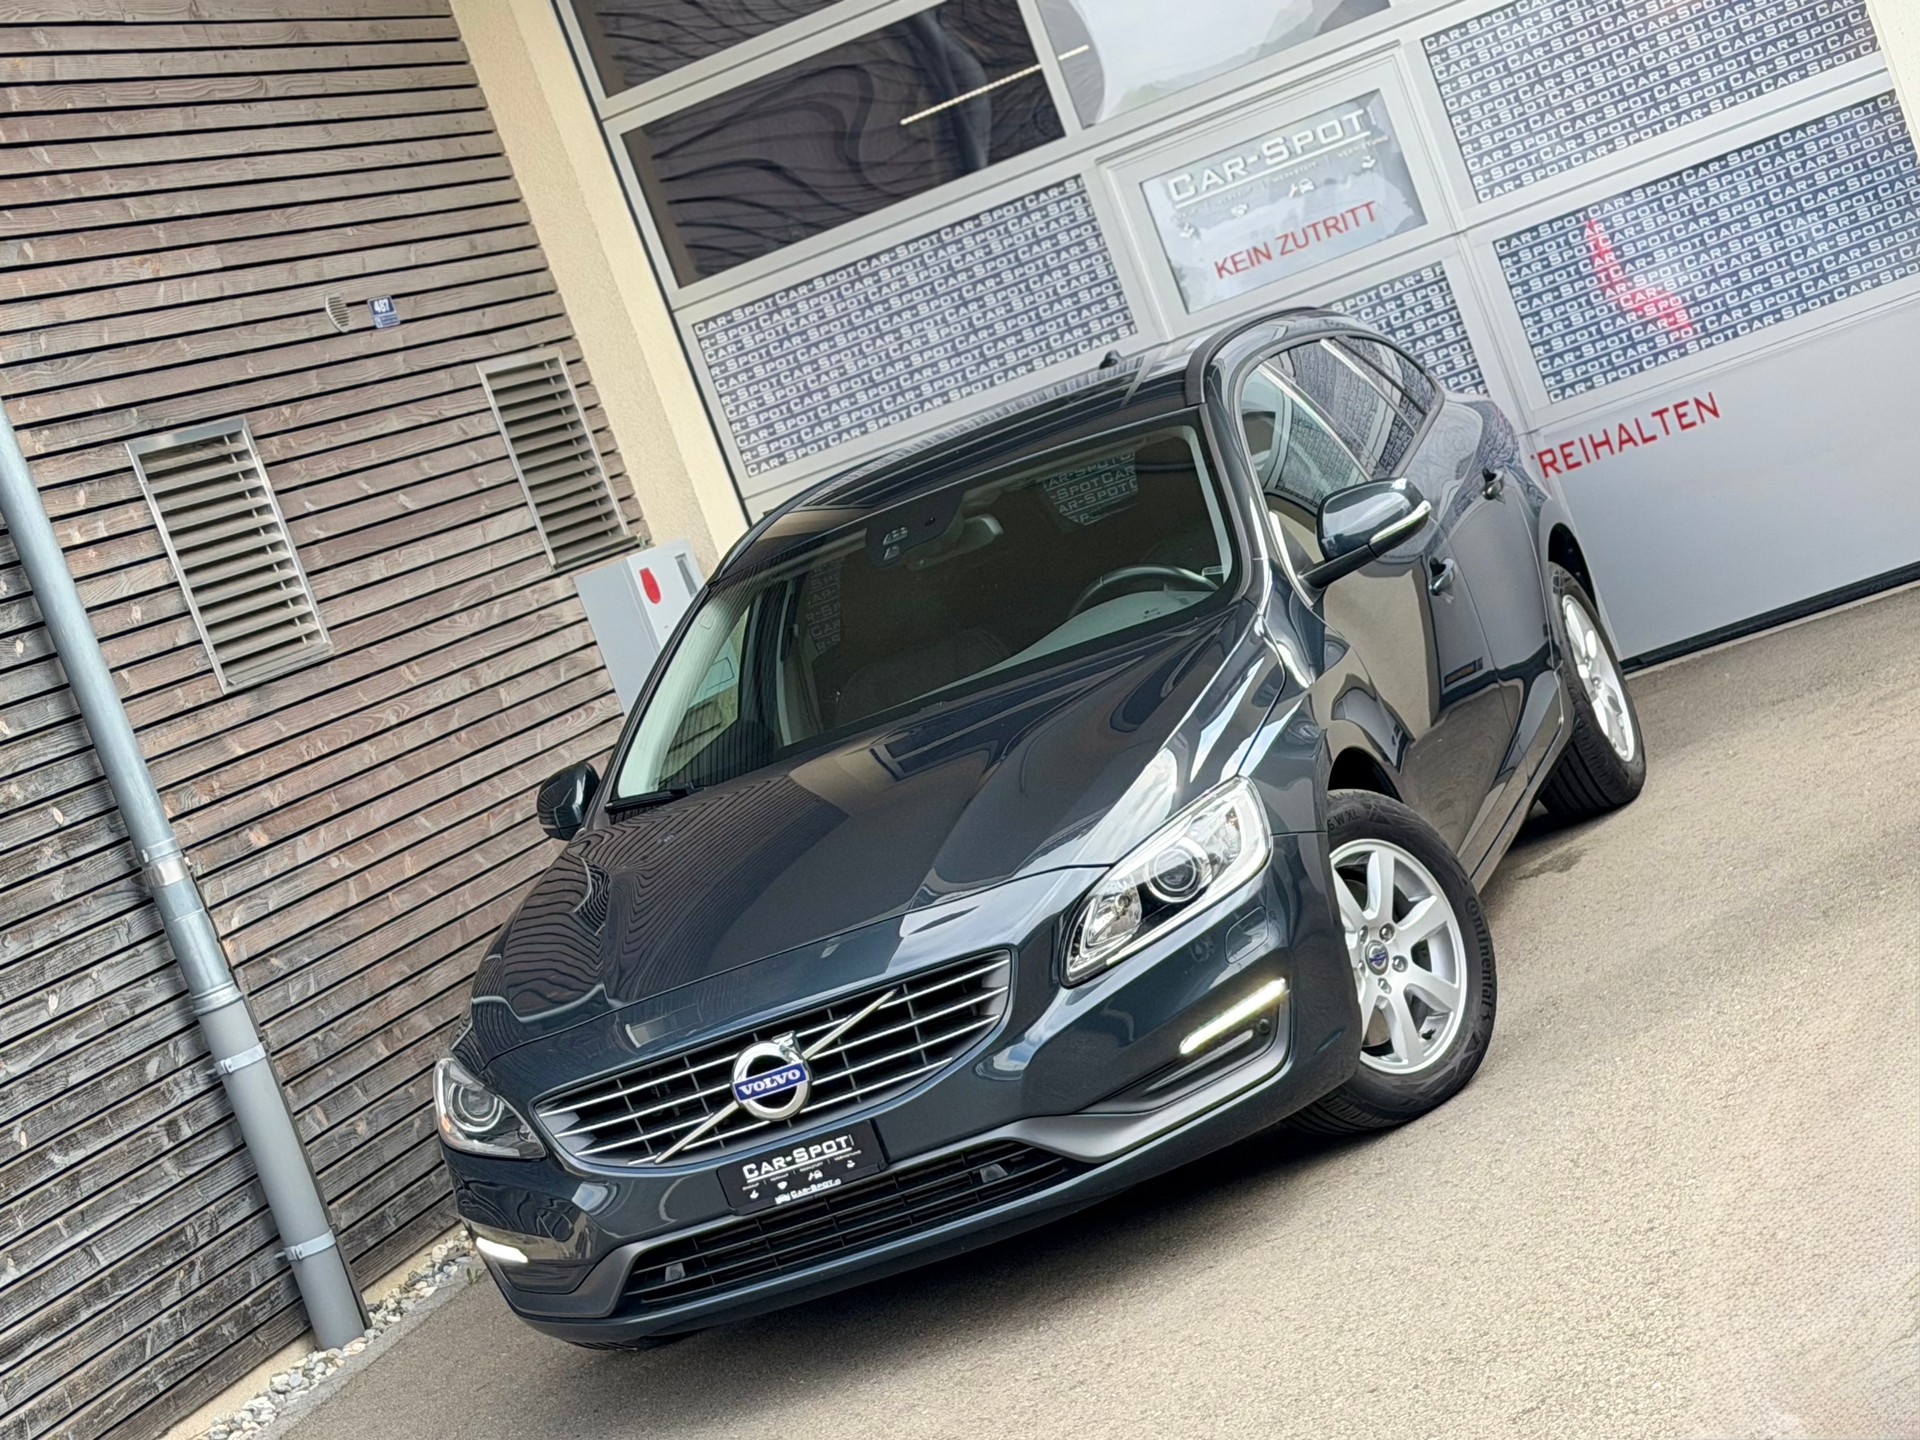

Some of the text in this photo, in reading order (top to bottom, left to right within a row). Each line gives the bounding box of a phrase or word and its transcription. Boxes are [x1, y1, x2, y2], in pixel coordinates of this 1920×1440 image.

[1423, 6, 1513, 50] CAR-SPOT
[1433, 0, 1617, 79] CAR-SPOT CAR-SPOT
[1444, 67, 1535, 111] CAR-SPOT
[1536, 30, 1628, 74] CAR-SPOT
[1454, 22, 1735, 140] CAR-SPOT CAR-SPOT CAR-SPOT
[1506, 24, 1598, 68] CAR-SPOT
[1517, 55, 1609, 99] CAR-SPOT
[1611, 18, 1704, 62] CAR-SPOT
[1527, 85, 1620, 129] CAR-SPOT
[1621, 48, 1715, 92] CAR-SPOT
[1717, 10, 1812, 55] CAR-SPOT
[1465, 16, 1844, 171] CAR-SPOT CAR-SPOT CAR-SPOT CAR-SPOT
[1476, 48, 1856, 202] CAR-SPOT CAR-SPOT CAR-SPOT CAR-SPOT
[1538, 116, 1631, 160] CAR-SPOT
[1632, 79, 1726, 124] CAR-SPOT
[1728, 42, 1823, 87] CAR-SPOT
[1168, 108, 1366, 201] CAR-SPOT
[1494, 101, 1874, 253] CAR-SPOT CAR-SPOT CAR-SPOT CAR-SPOT
[1505, 131, 1884, 282] CAR-SPOT CAR-SPOT CAR-SPOT CAR-SPOT
[1567, 200, 1659, 243] CAR-SPOT
[1661, 164, 1755, 208] CAR-SPOT
[1757, 127, 1853, 172] CAR-SPOT
[693, 200, 1021, 335] CAR-SPOT CAR-SPOT CAR-SPOT CAR-SPOT
[1214, 200, 1377, 279] KEIN ZUTRITT
[1516, 163, 1896, 313] CAR-SPOT CAR-SPOT CAR-SPOT CAR-SPOT
[1526, 193, 1906, 342] CAR-SPOT CAR-SPOT CAR-SPOT CAR-SPOT
[1577, 230, 1670, 273] CAR-SPOT
[1671, 194, 1765, 237] CAR-SPOT
[1767, 158, 1863, 202] CAR-SPOT
[1588, 261, 1681, 303] CAR-SPOT
[1683, 226, 1777, 269] CAR-SPOT
[1778, 189, 1875, 233] CAR-SPOT
[703, 229, 1032, 363] CAR-SPOT CAR-SPOT CAR-SPOT CAR-SPOT
[714, 259, 1042, 391] CAR-SPOT CAR-SPOT CAR-SPOT CAR-SPOT
[757, 289, 837, 327] CAR-SPOT
[839, 257, 920, 296] CAR-SPOT
[922, 224, 1004, 264] CAR-SPOT
[767, 316, 847, 354] CAR-SPOT
[849, 284, 930, 323] CAR-SPOT
[932, 252, 1014, 292] CAR-SPOT
[778, 346, 858, 384] CAR-SPOT
[860, 314, 941, 353] CAR-SPOT
[943, 282, 1025, 321] CAR-SPOT
[1537, 225, 1918, 373] CAR-SPOT CAR-SPOT CAR-SPOT CAR-SPOT
[1548, 262, 1919, 403] CAR-SPOT CAR-SPOT CAR-SPOT CAR-SPO
[1598, 290, 1691, 332] CAR-SPOT
[1693, 255, 1787, 298] CAR-SPOT
[1789, 219, 1885, 263] CAR-SPOT
[1610, 322, 1702, 363] CAR-SPOT
[1704, 287, 1798, 329] CAR-SPOT
[1800, 251, 1897, 294] CAR-SPOT
[724, 287, 1053, 419] CAR-SPOT CAR-SPOT CAR-SPOT CAR-SPOT
[734, 316, 1063, 448] CAR-SPOT CAR-SPOT CAR-SPOT CAR-SPOT
[788, 373, 868, 411] CAR-SPOT
[870, 341, 951, 380] CAR-SPOT
[953, 310, 1035, 349] CAR-SPOT
[799, 402, 879, 440] CAR-SPOT
[880, 371, 962, 409] CAR-SPOT
[964, 340, 1046, 378] CAR-SPOT
[745, 346, 1074, 477] CAR-SPOT CAR-SPOT CAR-SPOT CAR-SPOT
[1530, 391, 1721, 478] REIHALTEN
[739, 1069, 800, 1096] VOLVO
[743, 1135, 848, 1179] CAR-SPOT
